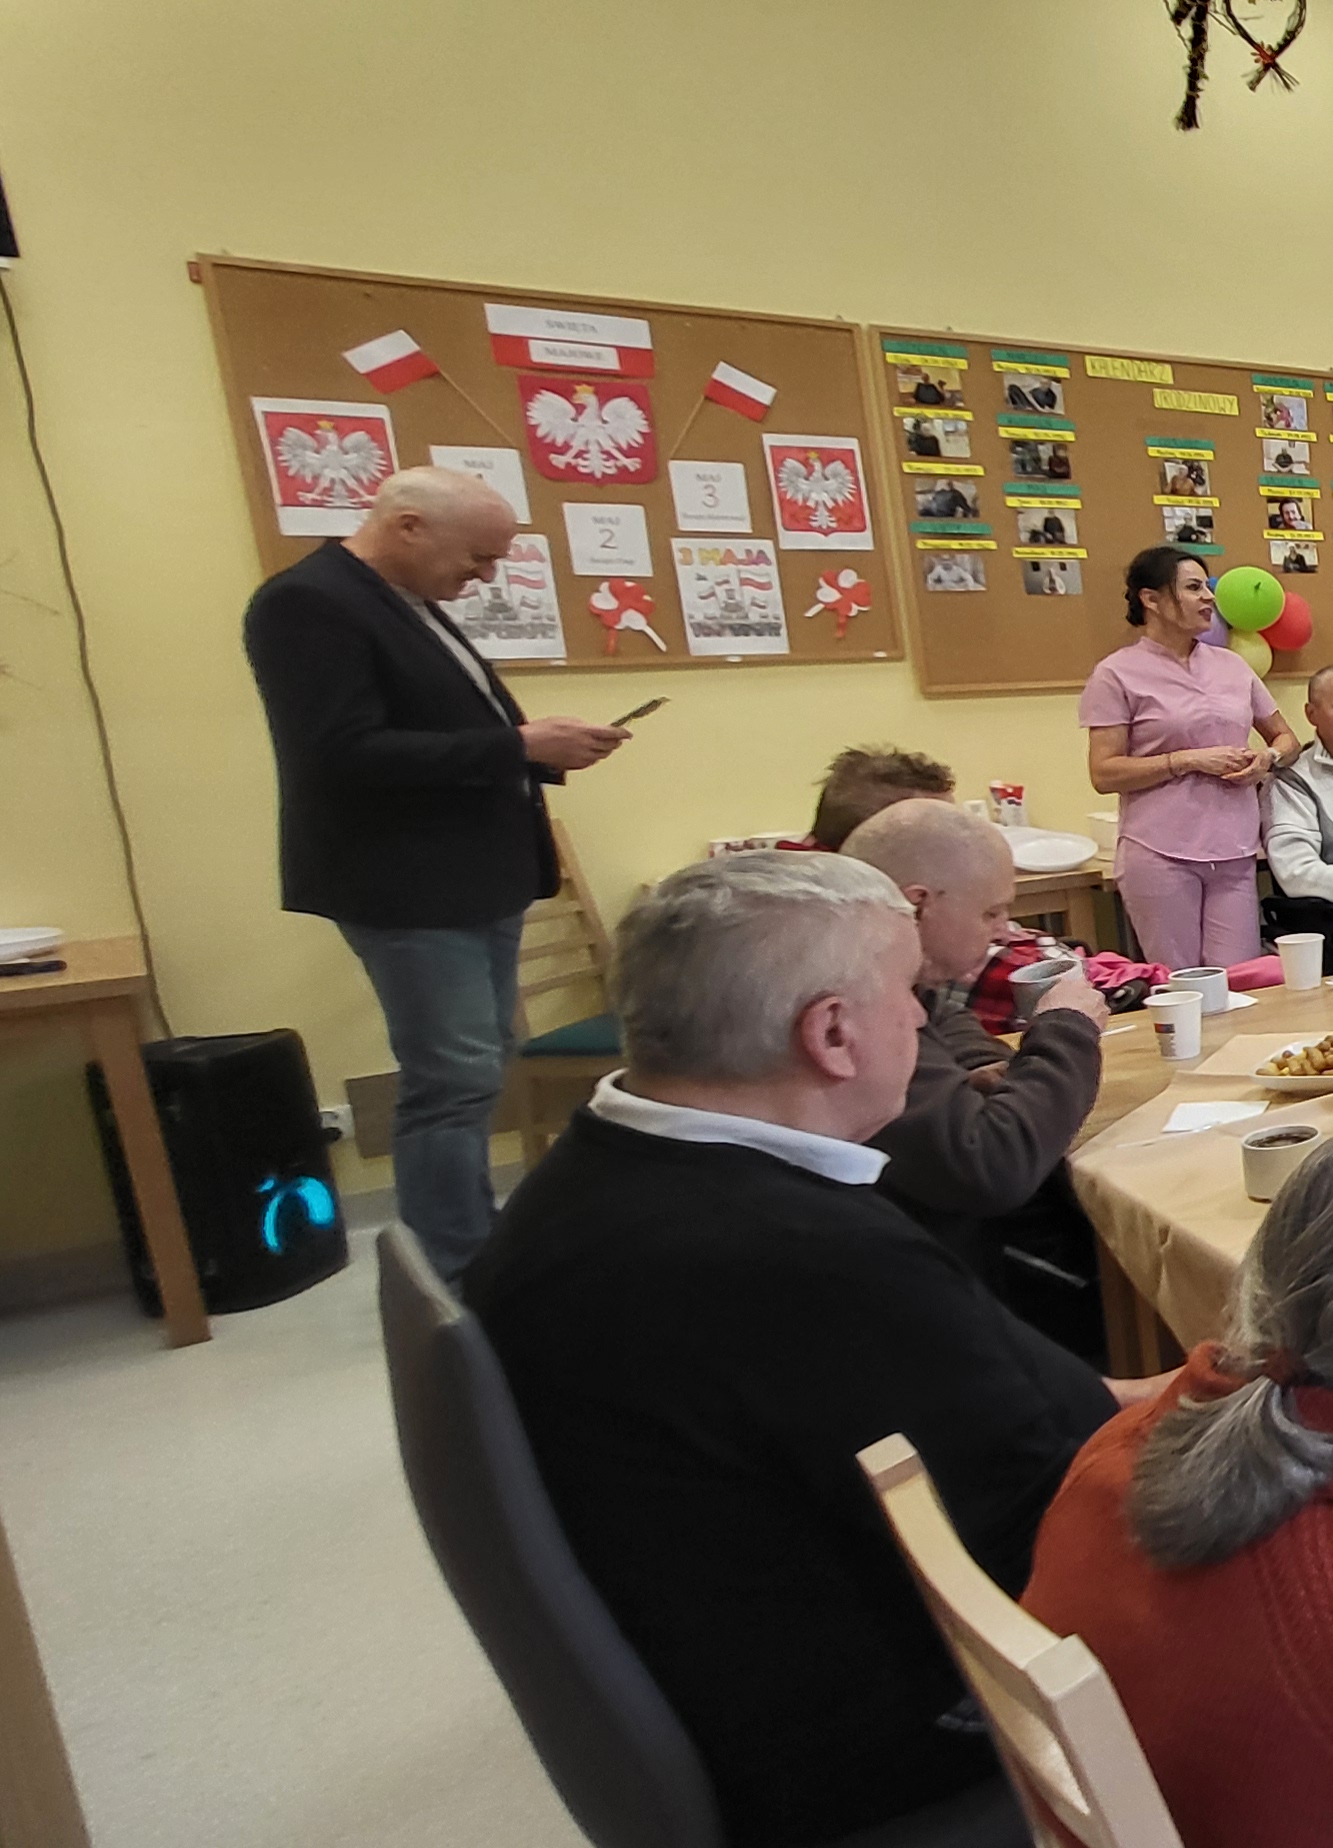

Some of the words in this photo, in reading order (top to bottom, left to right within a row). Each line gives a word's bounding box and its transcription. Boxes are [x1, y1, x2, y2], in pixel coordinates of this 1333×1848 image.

[1091, 360, 1168, 382] KALENDARZ
[702, 484, 720, 509] 3
[599, 528, 619, 550] 2
[698, 547, 773, 567] MAJA
